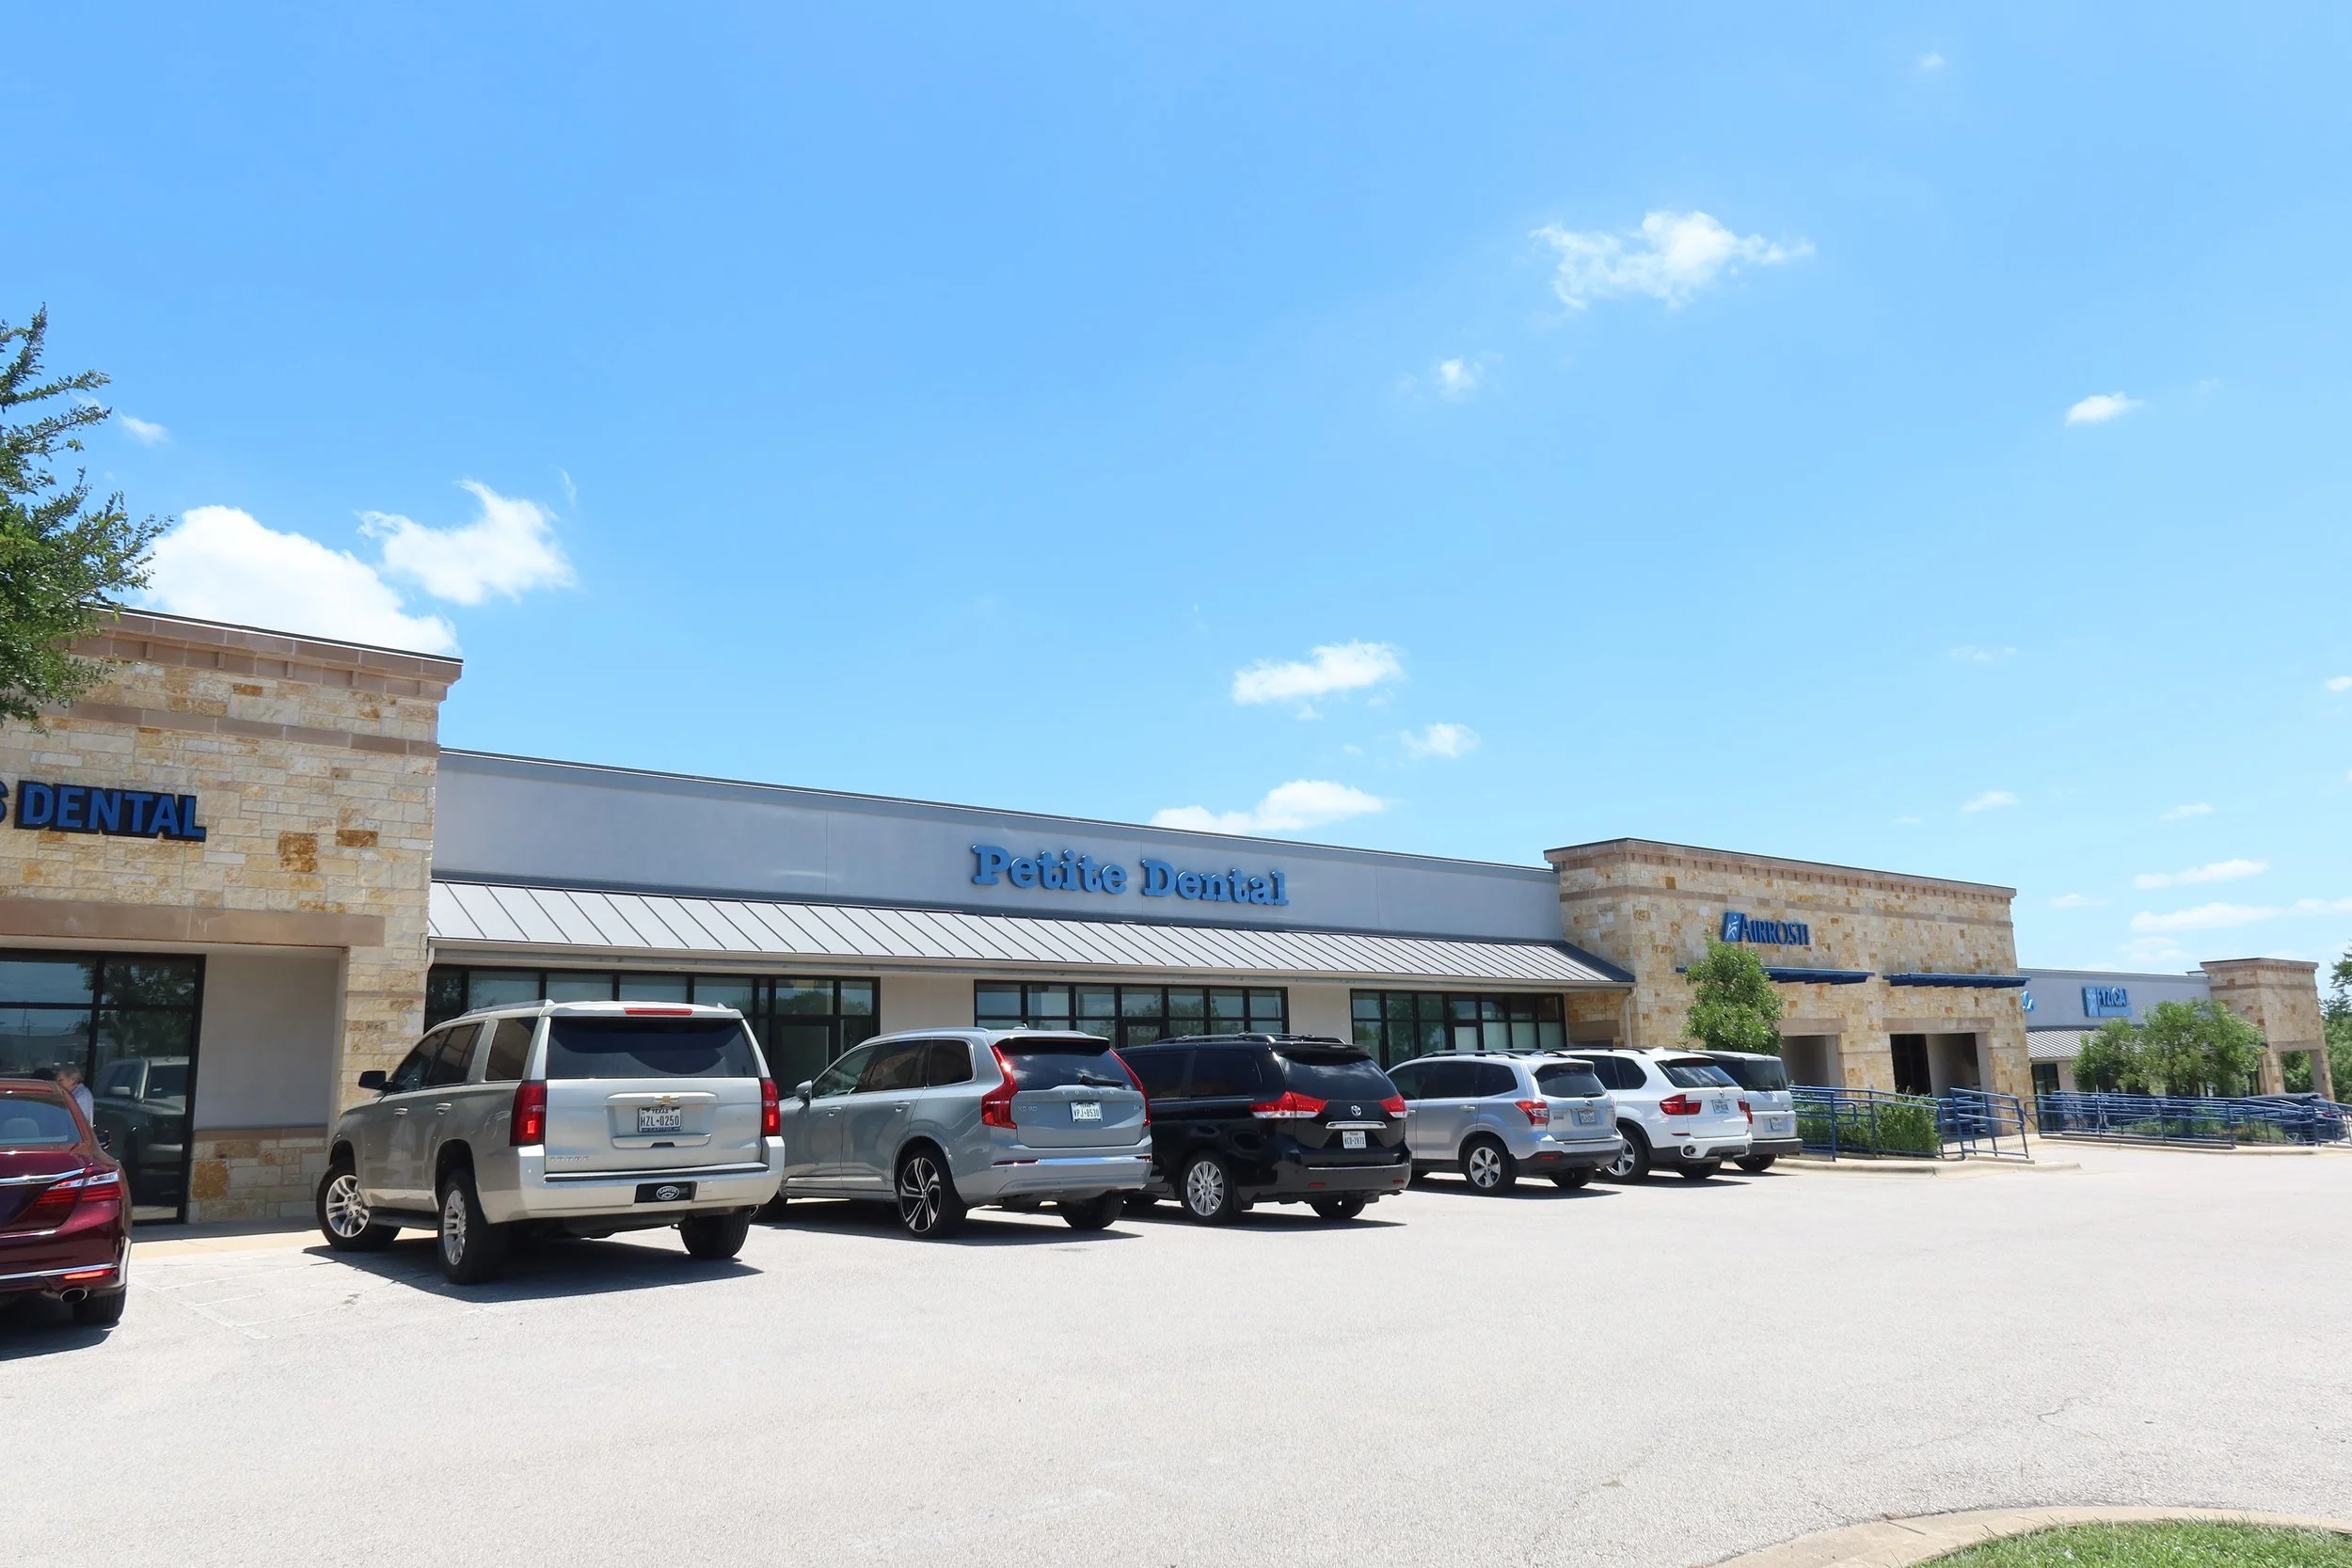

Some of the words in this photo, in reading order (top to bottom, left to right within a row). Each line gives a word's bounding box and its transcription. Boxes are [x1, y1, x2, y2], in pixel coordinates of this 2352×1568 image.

[16, 780, 206, 841] DENTAL
[971, 844, 1127, 895] Petite
[1140, 859, 1290, 907] Dental
[1740, 912, 1810, 945] AIRROSTI
